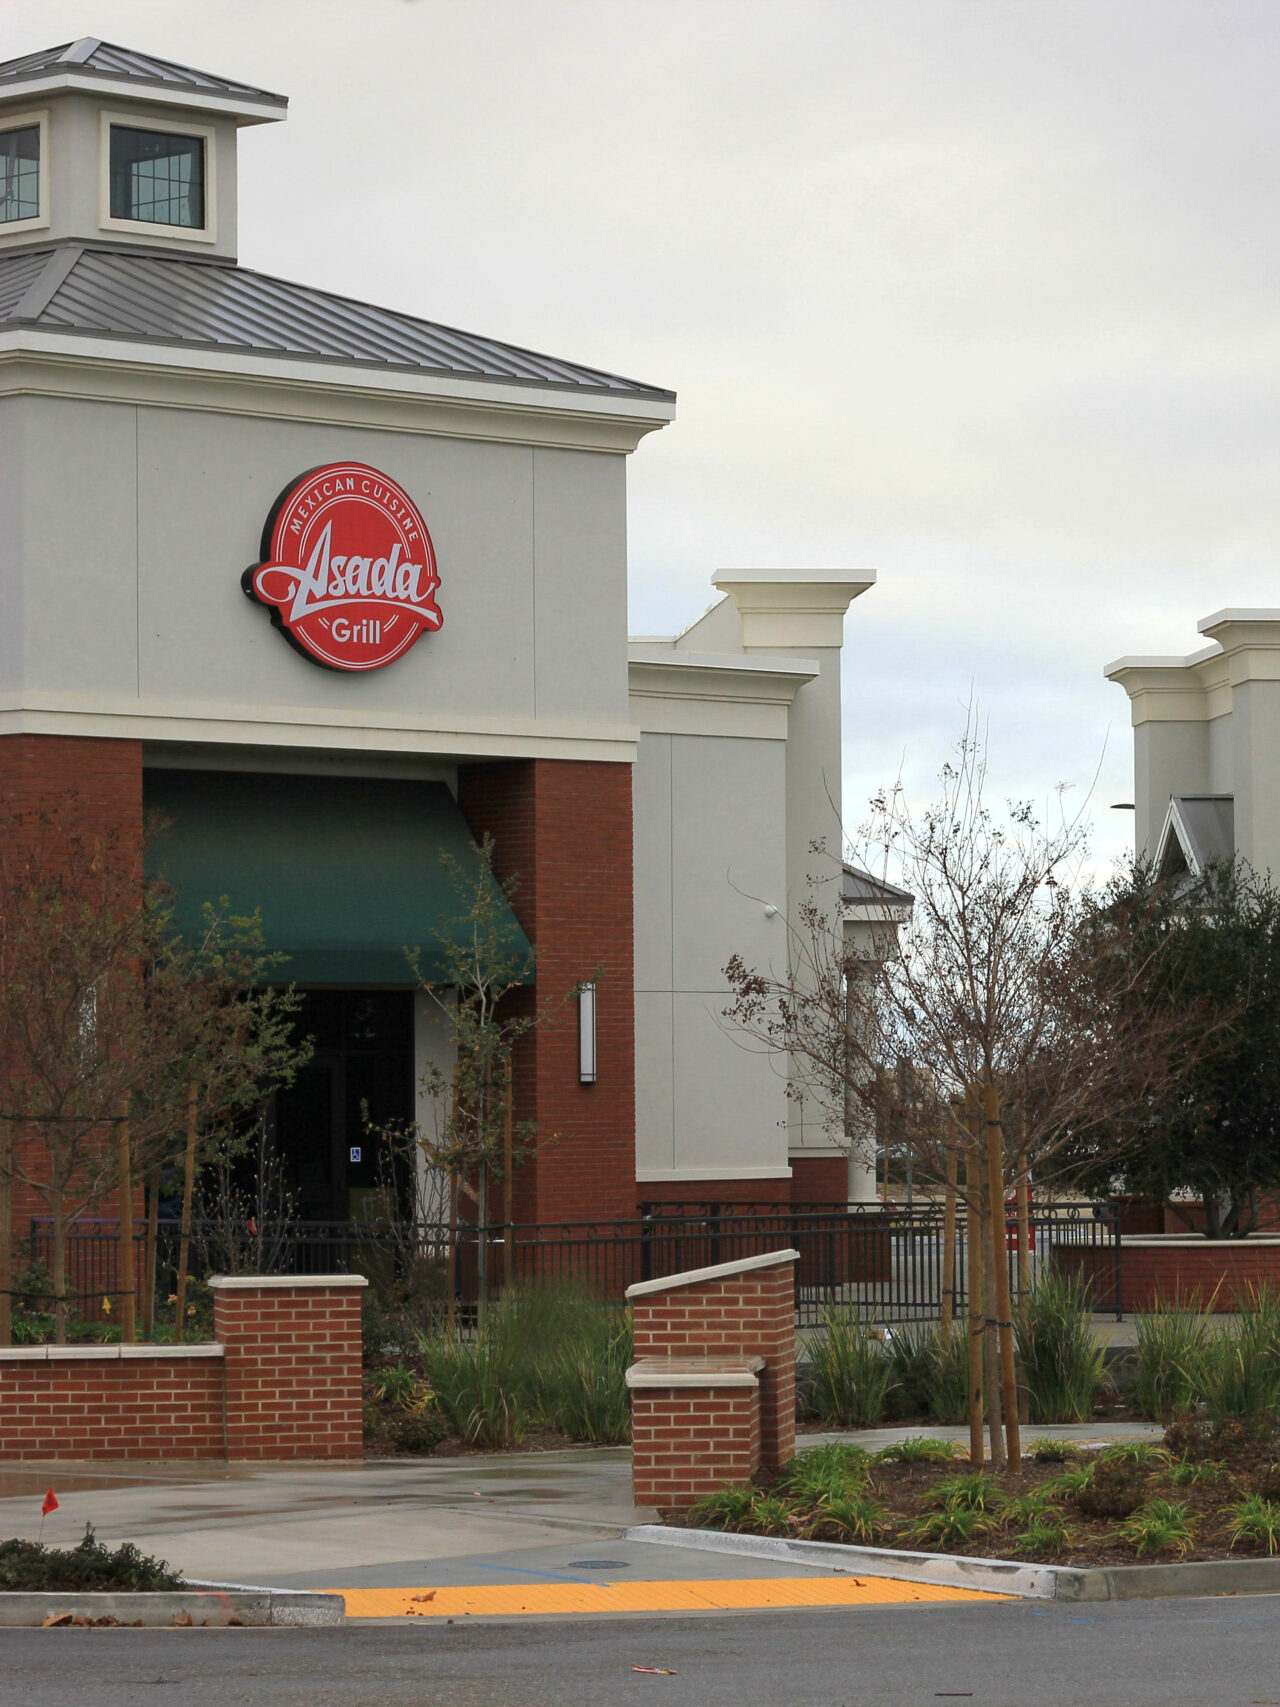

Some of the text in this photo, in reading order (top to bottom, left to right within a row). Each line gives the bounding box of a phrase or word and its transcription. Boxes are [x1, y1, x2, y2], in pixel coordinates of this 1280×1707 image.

[290, 477, 419, 542] MEXICAN CUISINE
[256, 519, 438, 622] Asada
[331, 617, 381, 644] Grill
